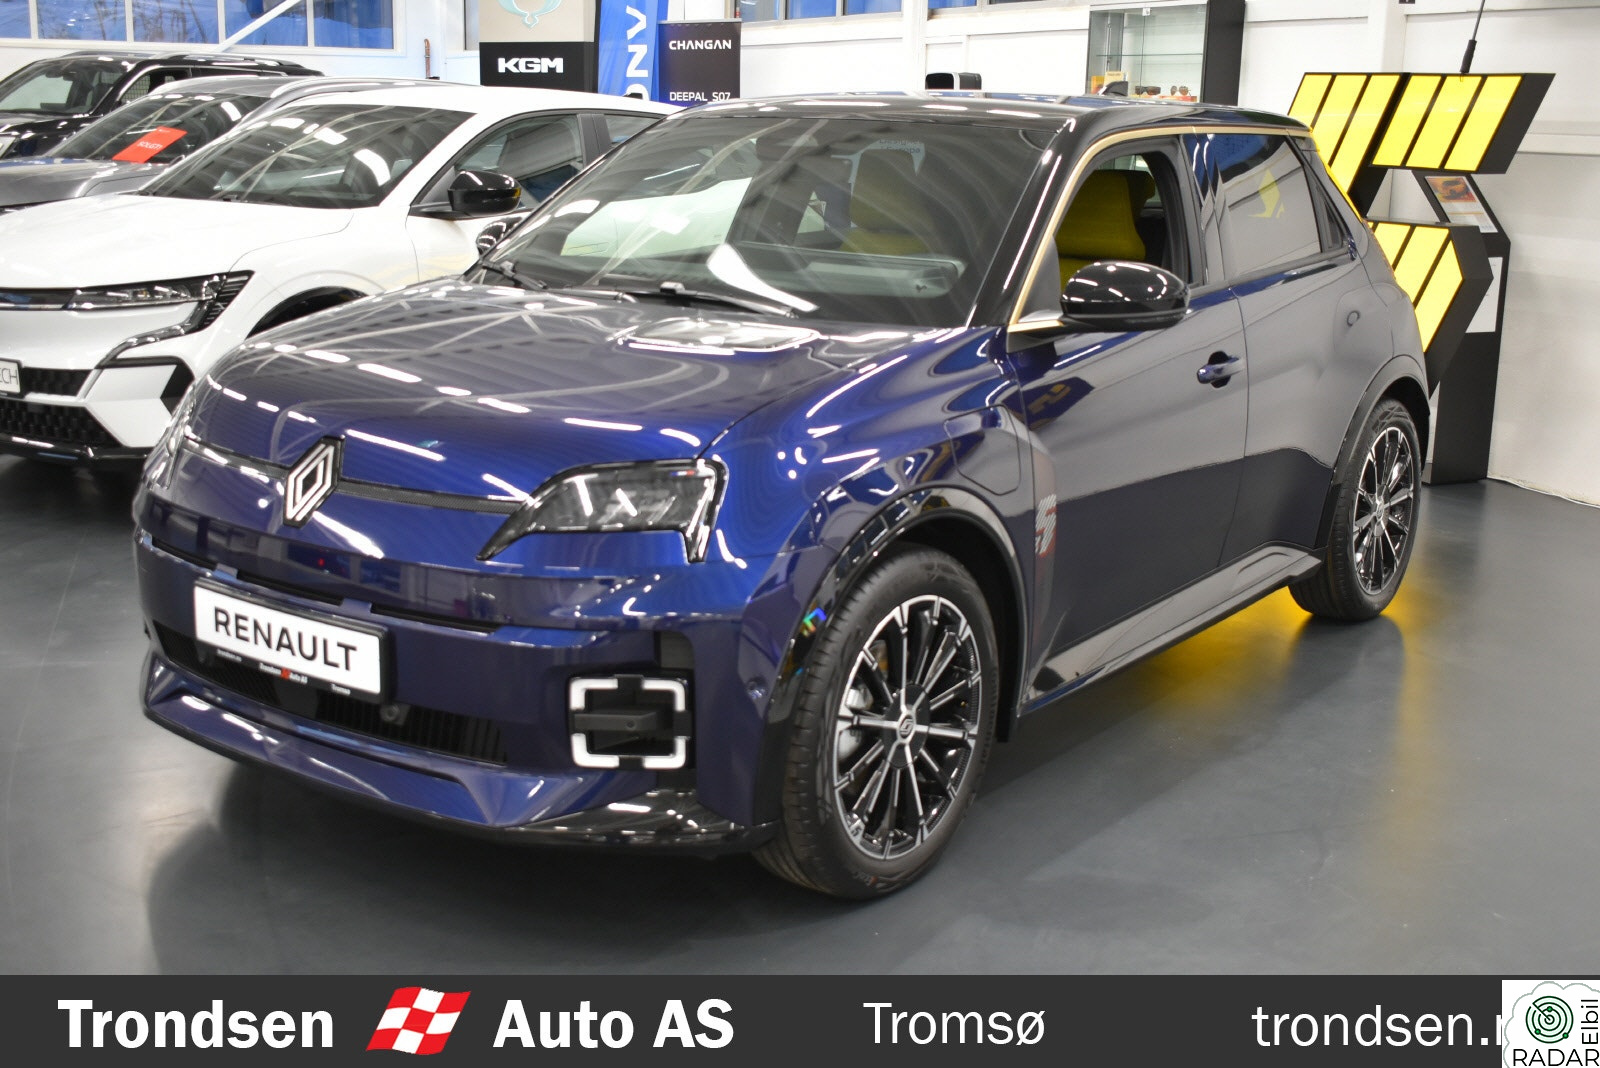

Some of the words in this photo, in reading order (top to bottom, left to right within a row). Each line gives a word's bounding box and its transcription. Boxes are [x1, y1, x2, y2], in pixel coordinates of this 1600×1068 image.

[669, 39, 732, 50] CHANGAN
[497, 57, 563, 74] KGM
[669, 91, 708, 102] DEEPAL
[712, 91, 731, 101] S07
[214, 606, 358, 672] RENAULT
